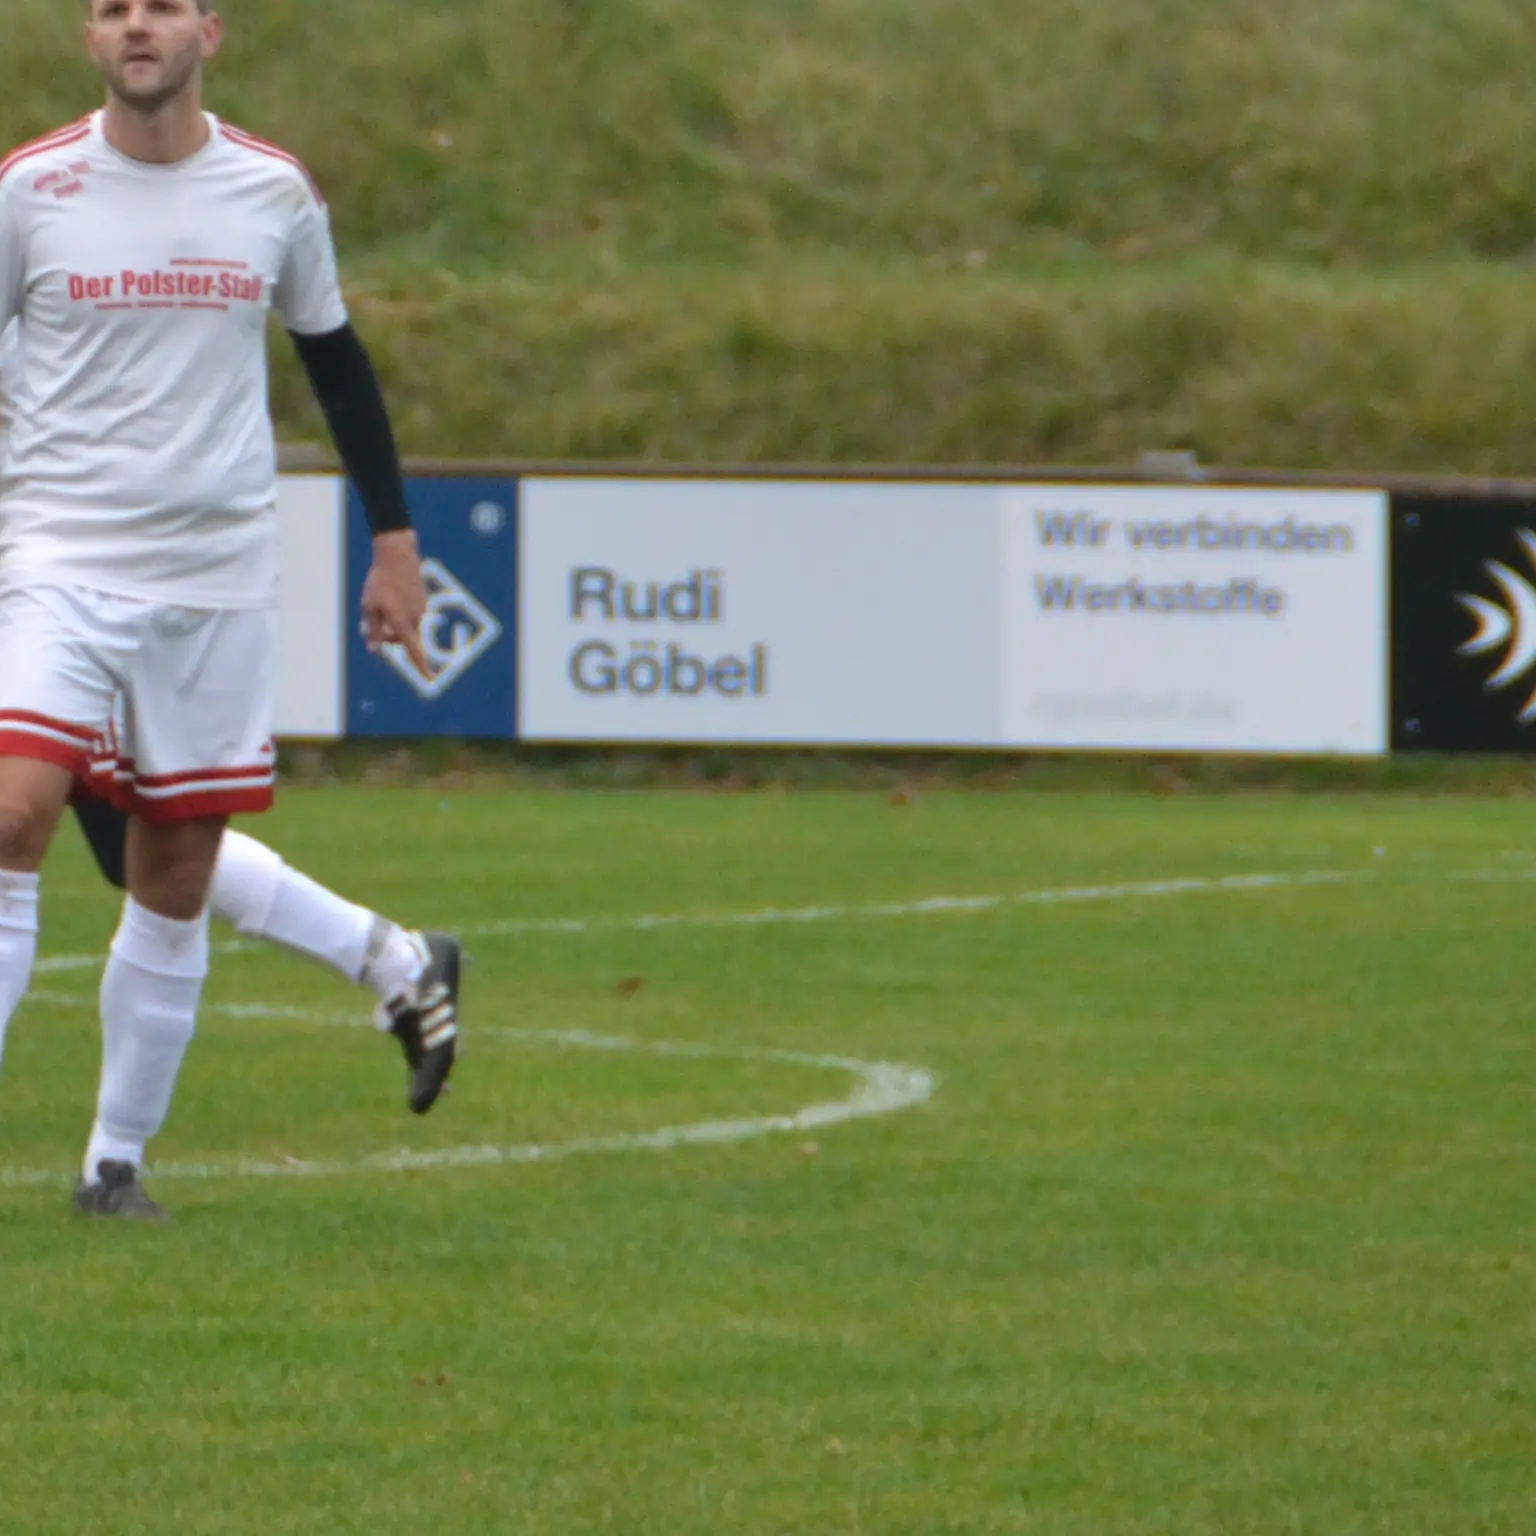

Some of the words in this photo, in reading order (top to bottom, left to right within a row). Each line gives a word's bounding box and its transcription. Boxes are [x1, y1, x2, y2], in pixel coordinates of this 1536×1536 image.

[68, 273, 114, 301] Der
[1034, 511, 1108, 547] Wir
[1126, 516, 1352, 552] verbinden
[567, 567, 722, 621] Rudi
[1034, 575, 1284, 615] Werkstoffe
[568, 640, 768, 697] Göbel
